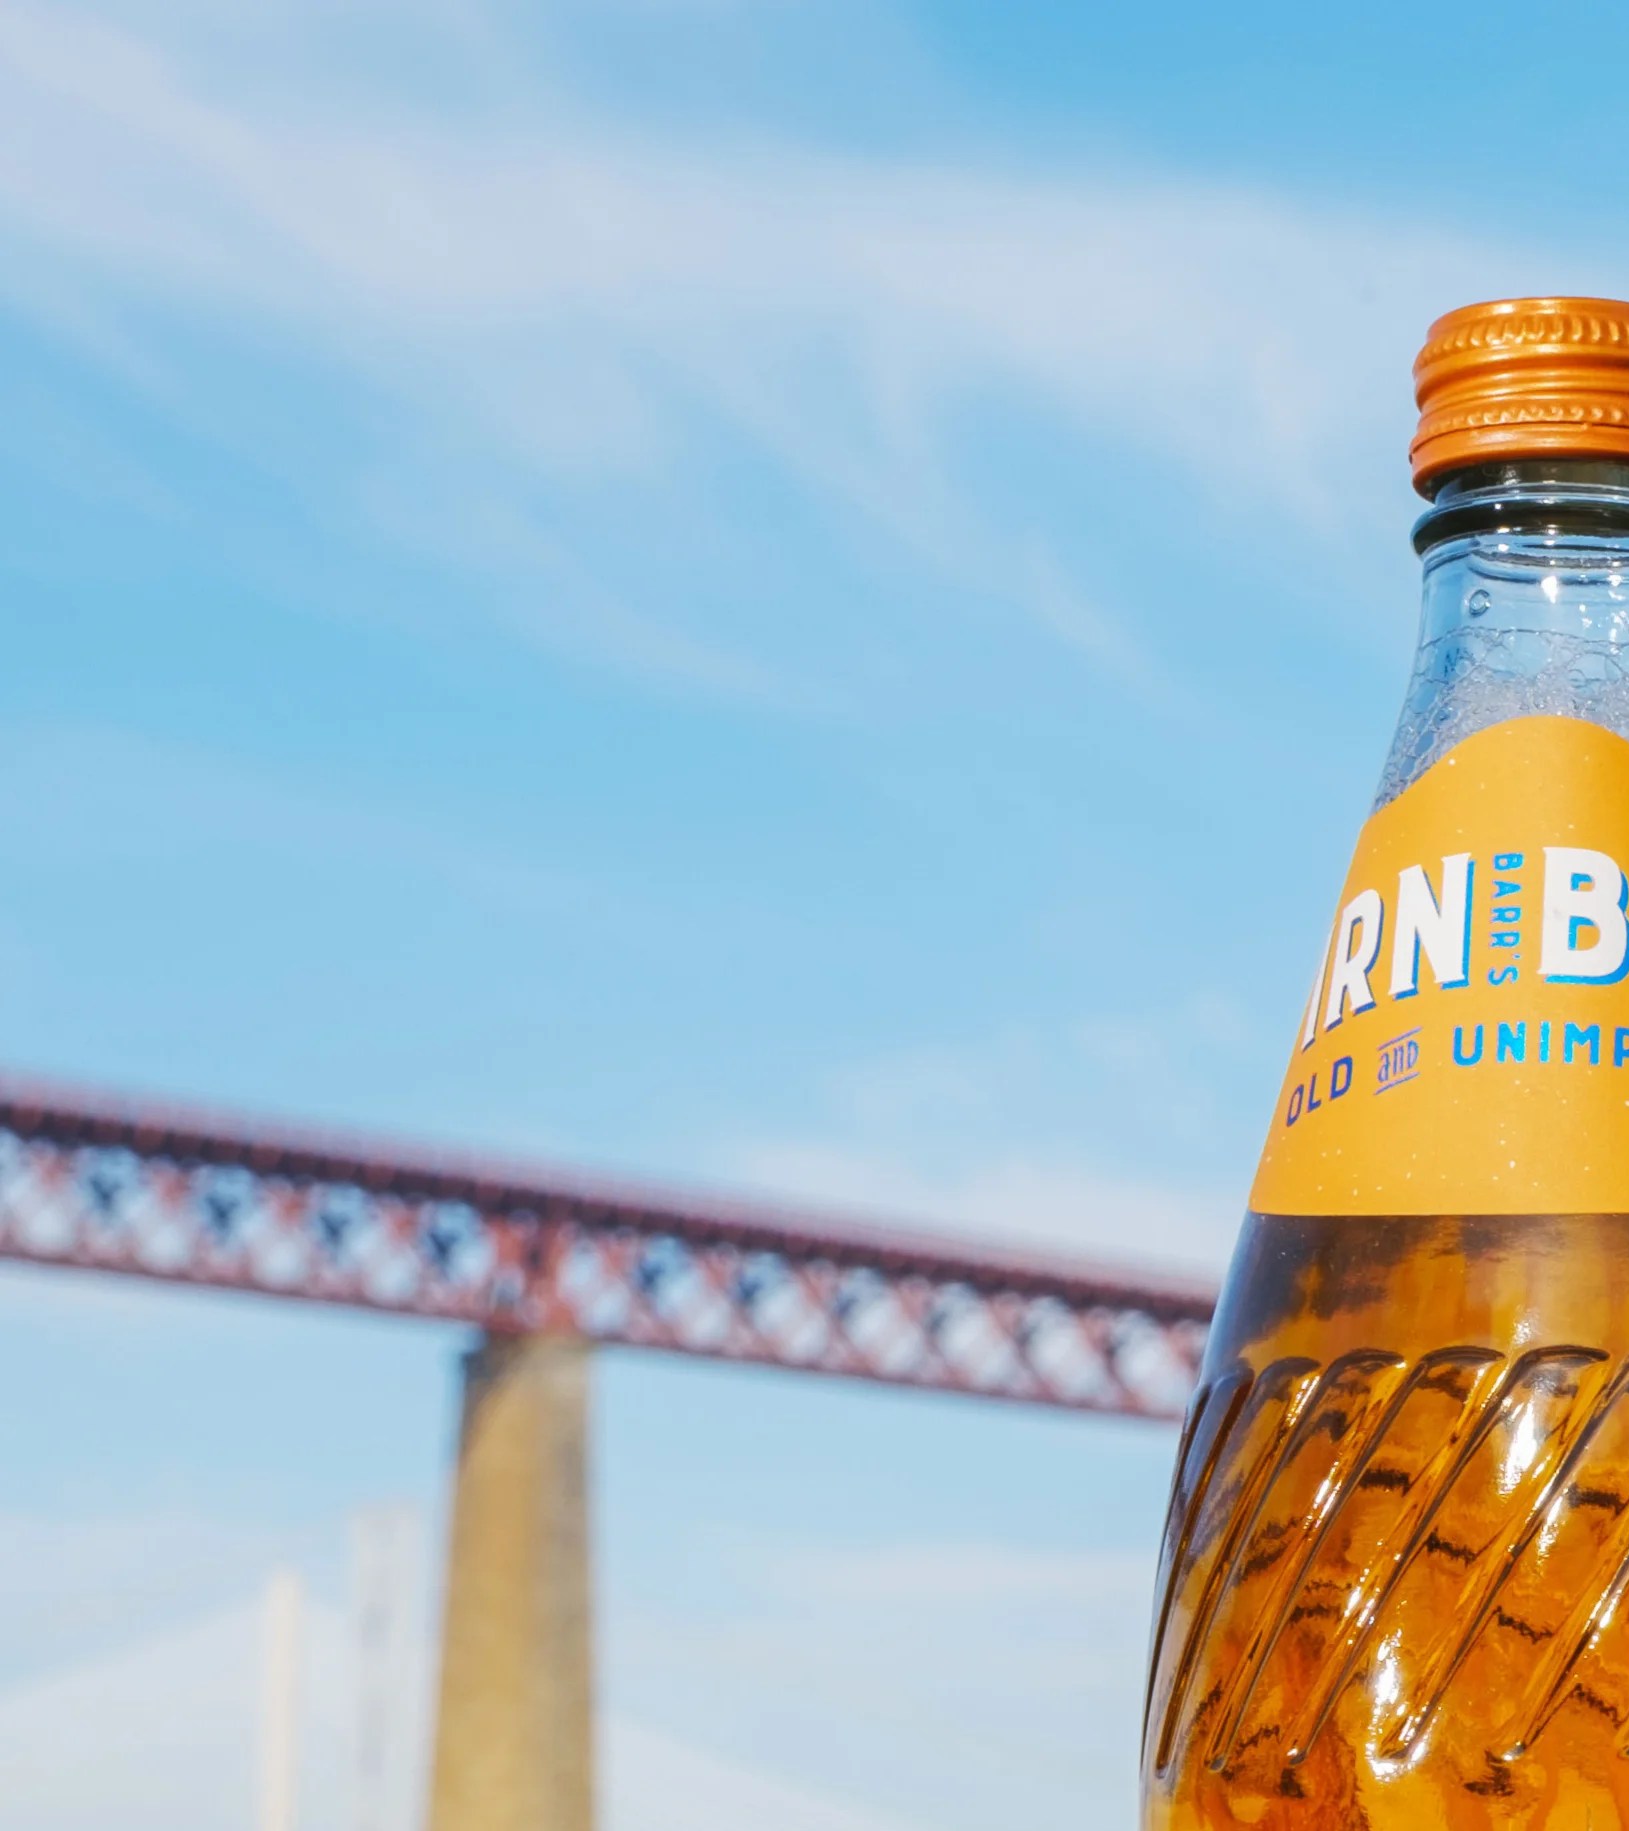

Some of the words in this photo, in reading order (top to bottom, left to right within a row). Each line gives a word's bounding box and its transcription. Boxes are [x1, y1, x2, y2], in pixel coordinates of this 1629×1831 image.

[1301, 852, 1475, 1053] IRN
[1487, 851, 1524, 987] BARR'S
[1285, 1054, 1354, 1128] OLD
